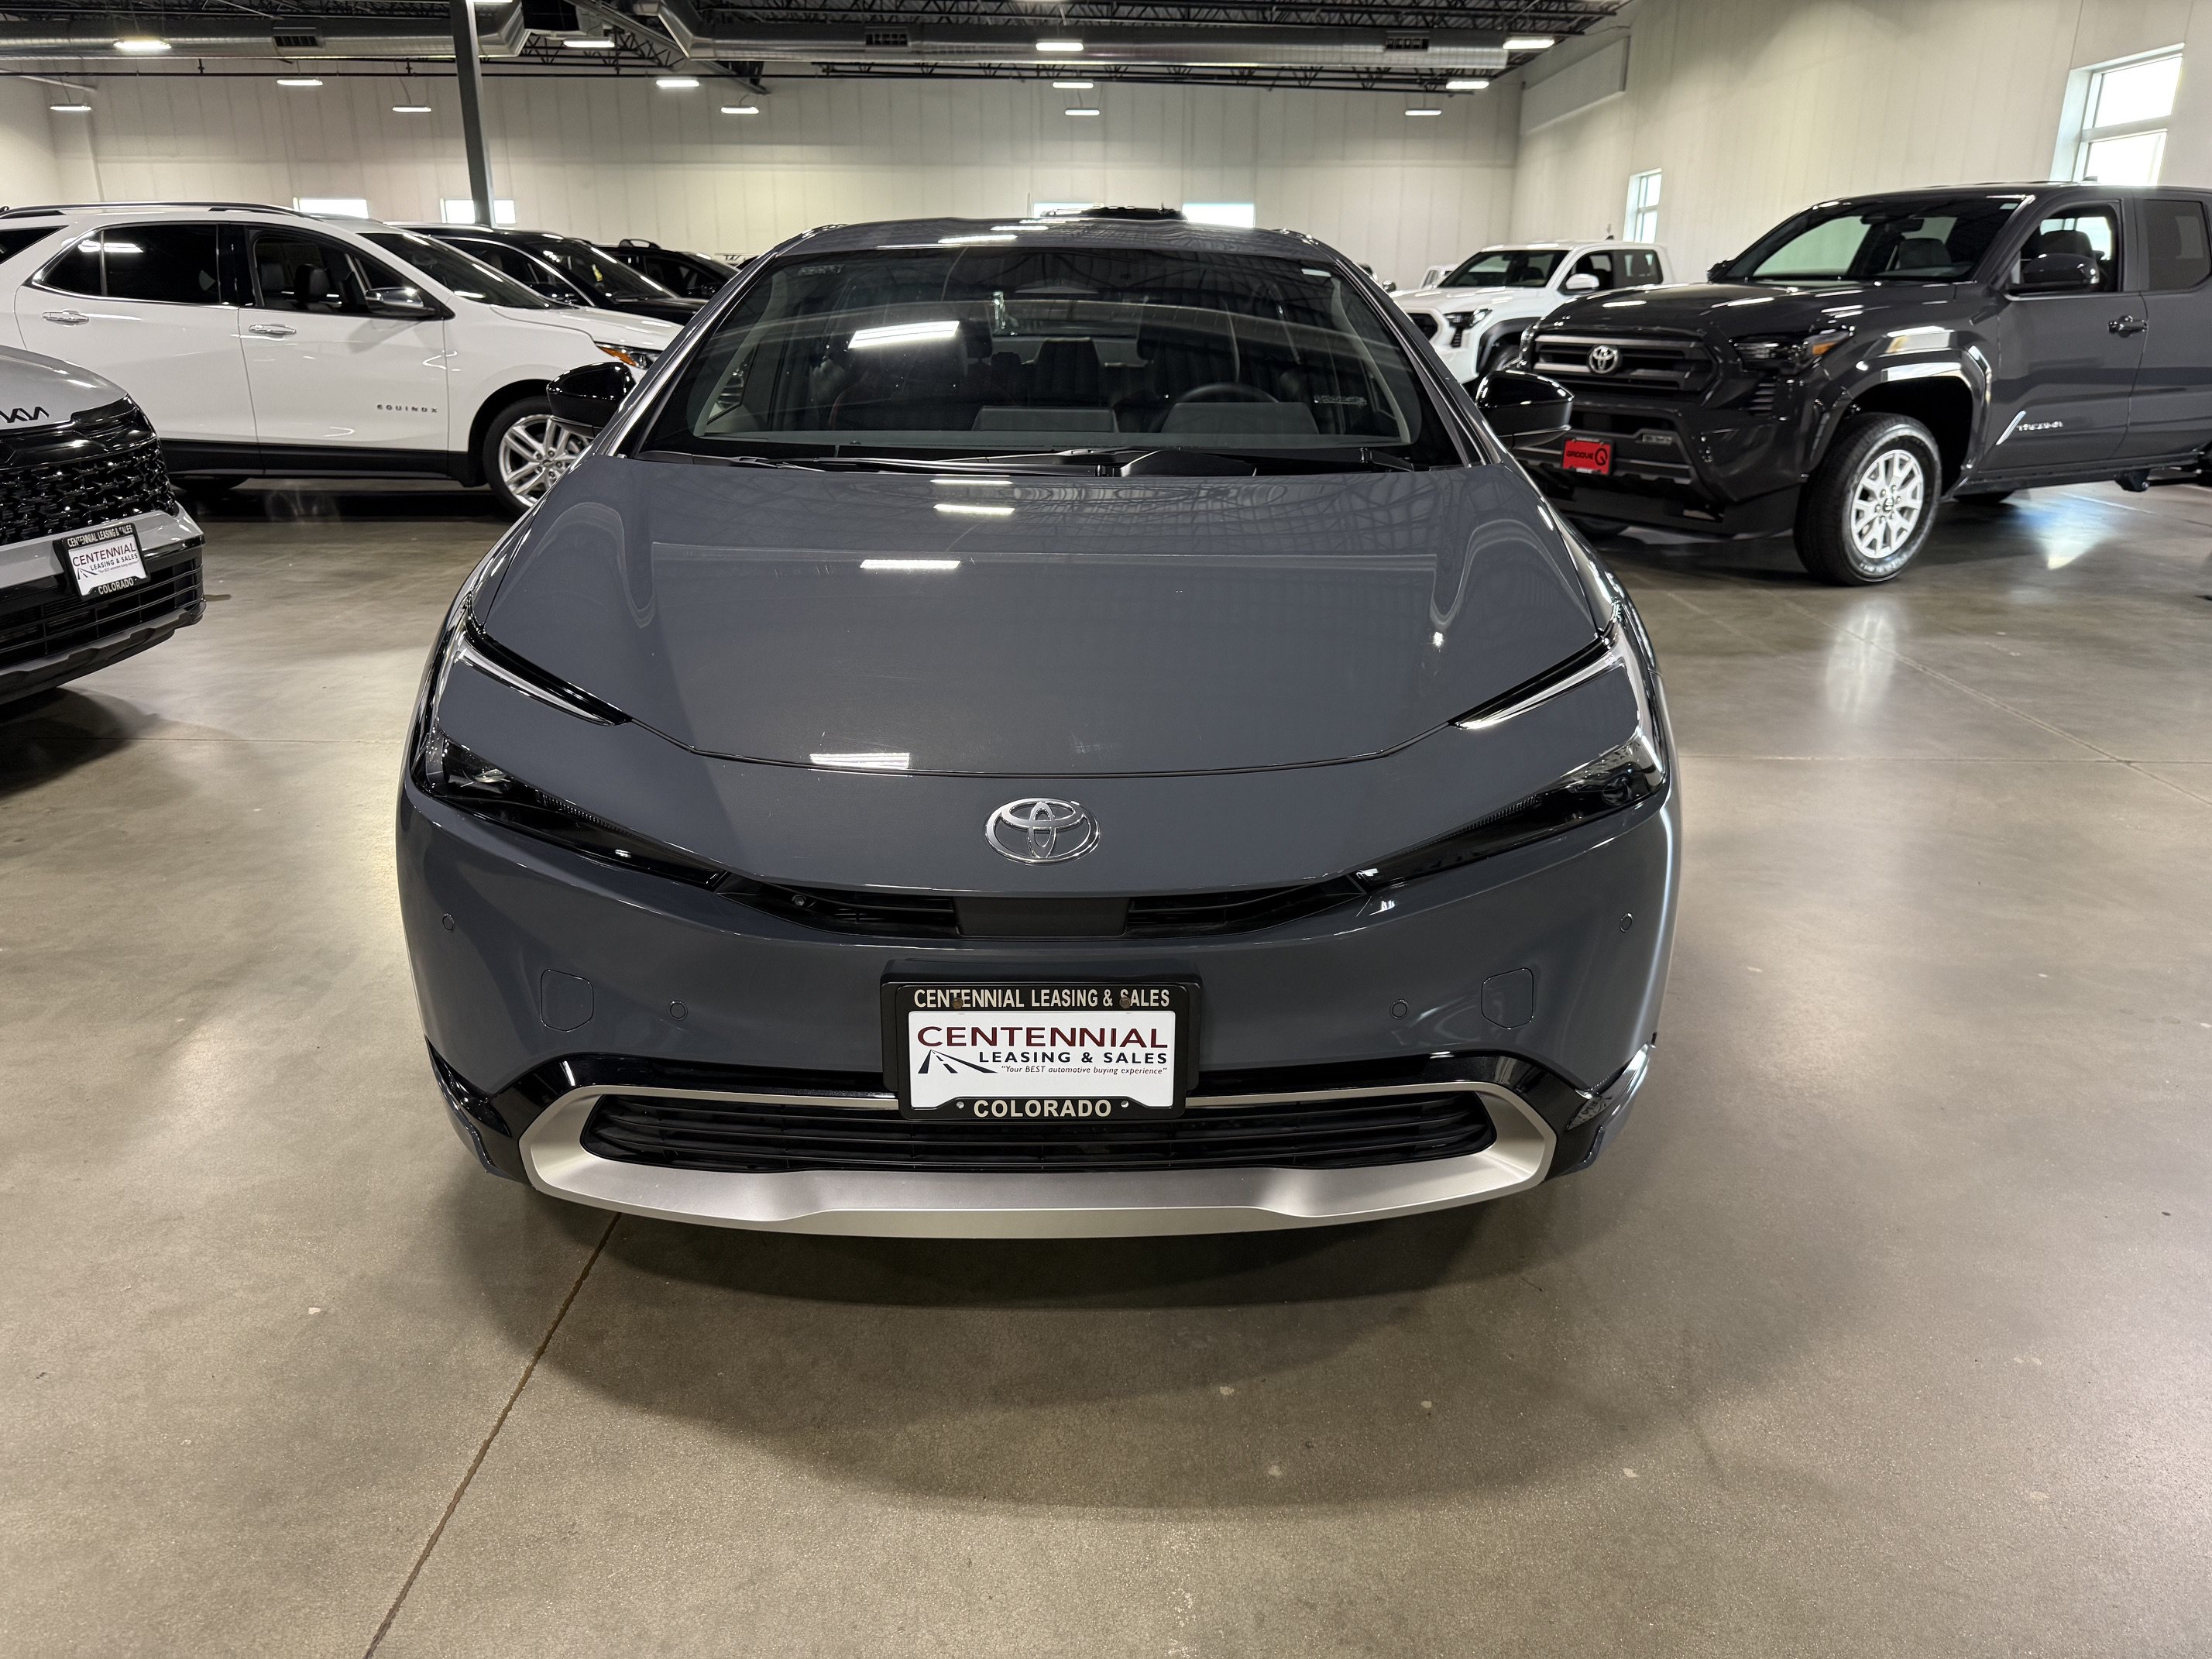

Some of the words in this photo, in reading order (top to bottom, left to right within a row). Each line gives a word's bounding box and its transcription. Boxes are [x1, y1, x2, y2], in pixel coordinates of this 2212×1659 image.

[377, 404, 437, 413] EQUINOX
[67, 534, 98, 547] CENTENNIAL
[98, 530, 116, 540] LEASING
[73, 543, 136, 566] CENTENNIAL
[91, 559, 115, 571] LEASING
[121, 553, 138, 562] SALES
[98, 577, 134, 594] COLORADO
[914, 989, 1024, 1008] CENTENNIAL
[1032, 989, 1098, 1007] LEASING
[1103, 989, 1113, 1007] &
[917, 1026, 1168, 1048] CENTENNIAL
[979, 1051, 1071, 1063] LEASING
[1081, 1052, 1093, 1063] &
[1103, 1052, 1167, 1064] SALES
[1094, 1066, 1118, 1075] buying
[974, 1099, 1111, 1117] COLORADO
